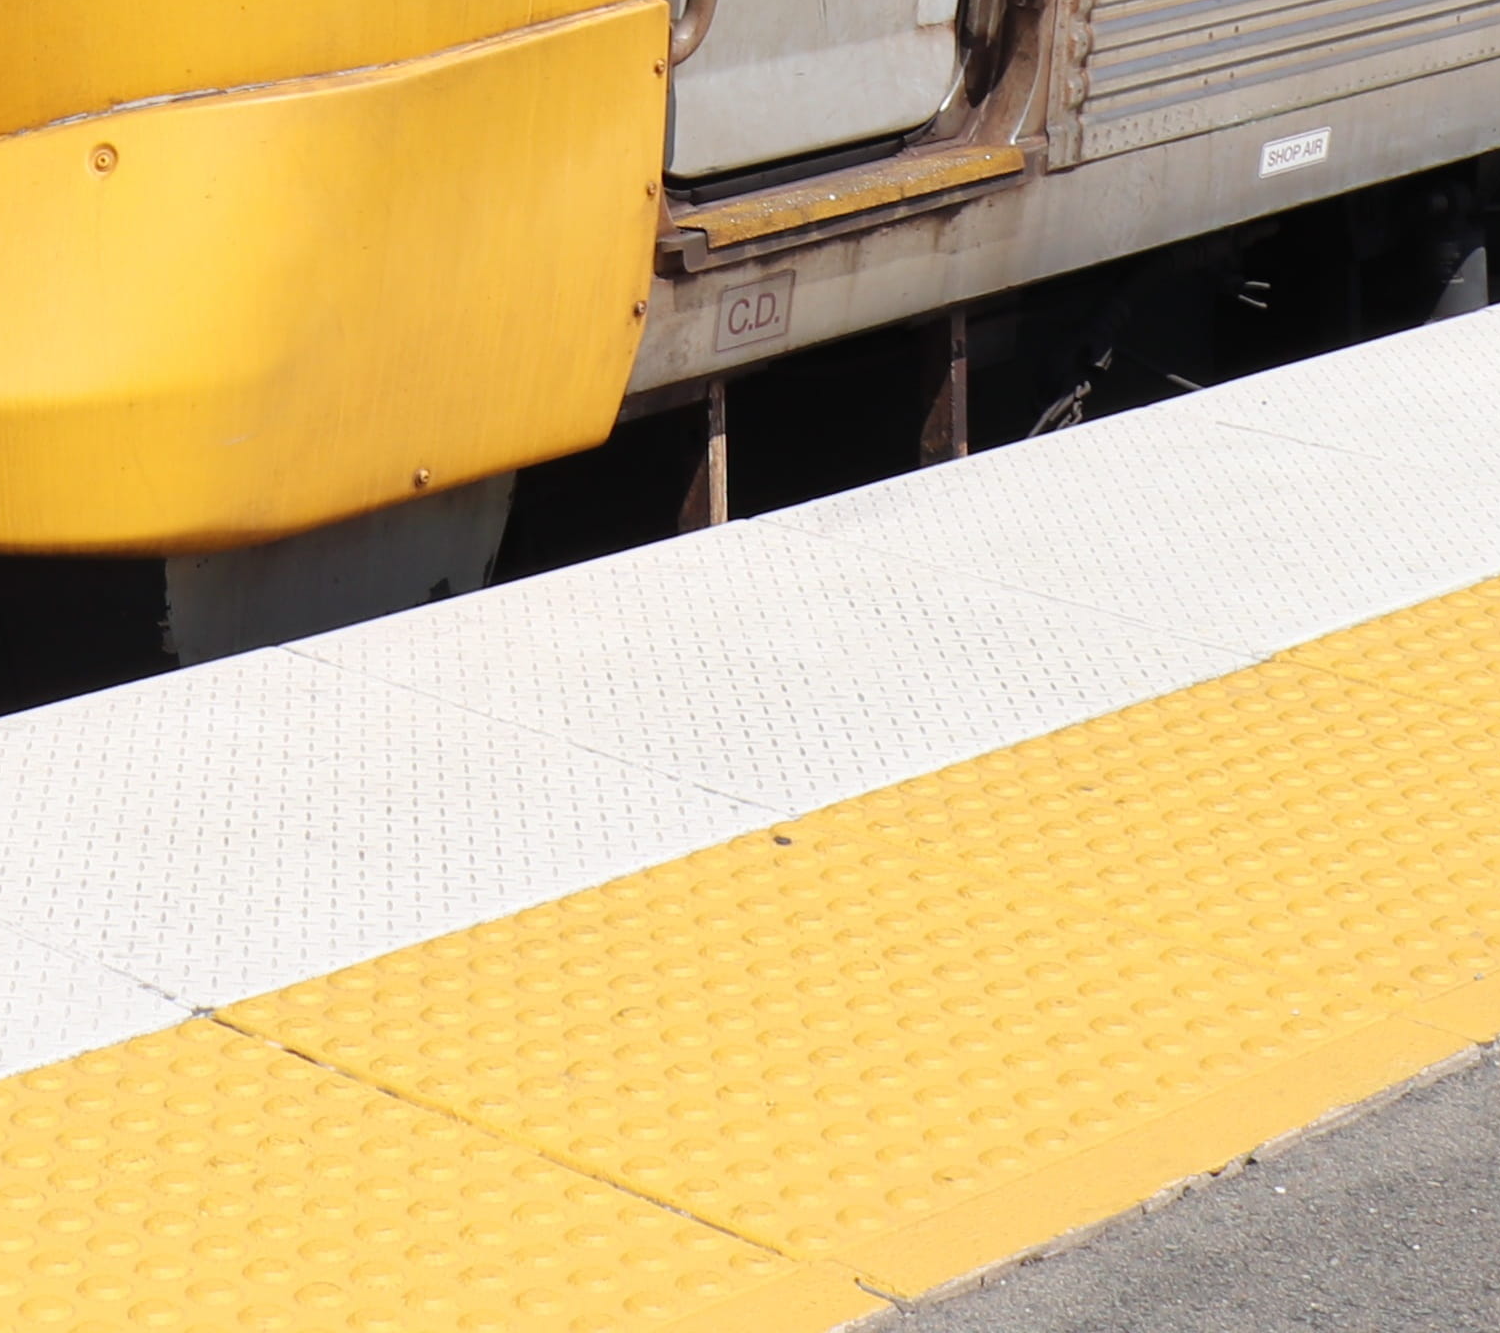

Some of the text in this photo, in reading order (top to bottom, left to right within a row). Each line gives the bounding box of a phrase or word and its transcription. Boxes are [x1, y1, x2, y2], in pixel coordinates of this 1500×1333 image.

[1267, 138, 1324, 167] SHOP AIR
[727, 293, 780, 335] C.D.
